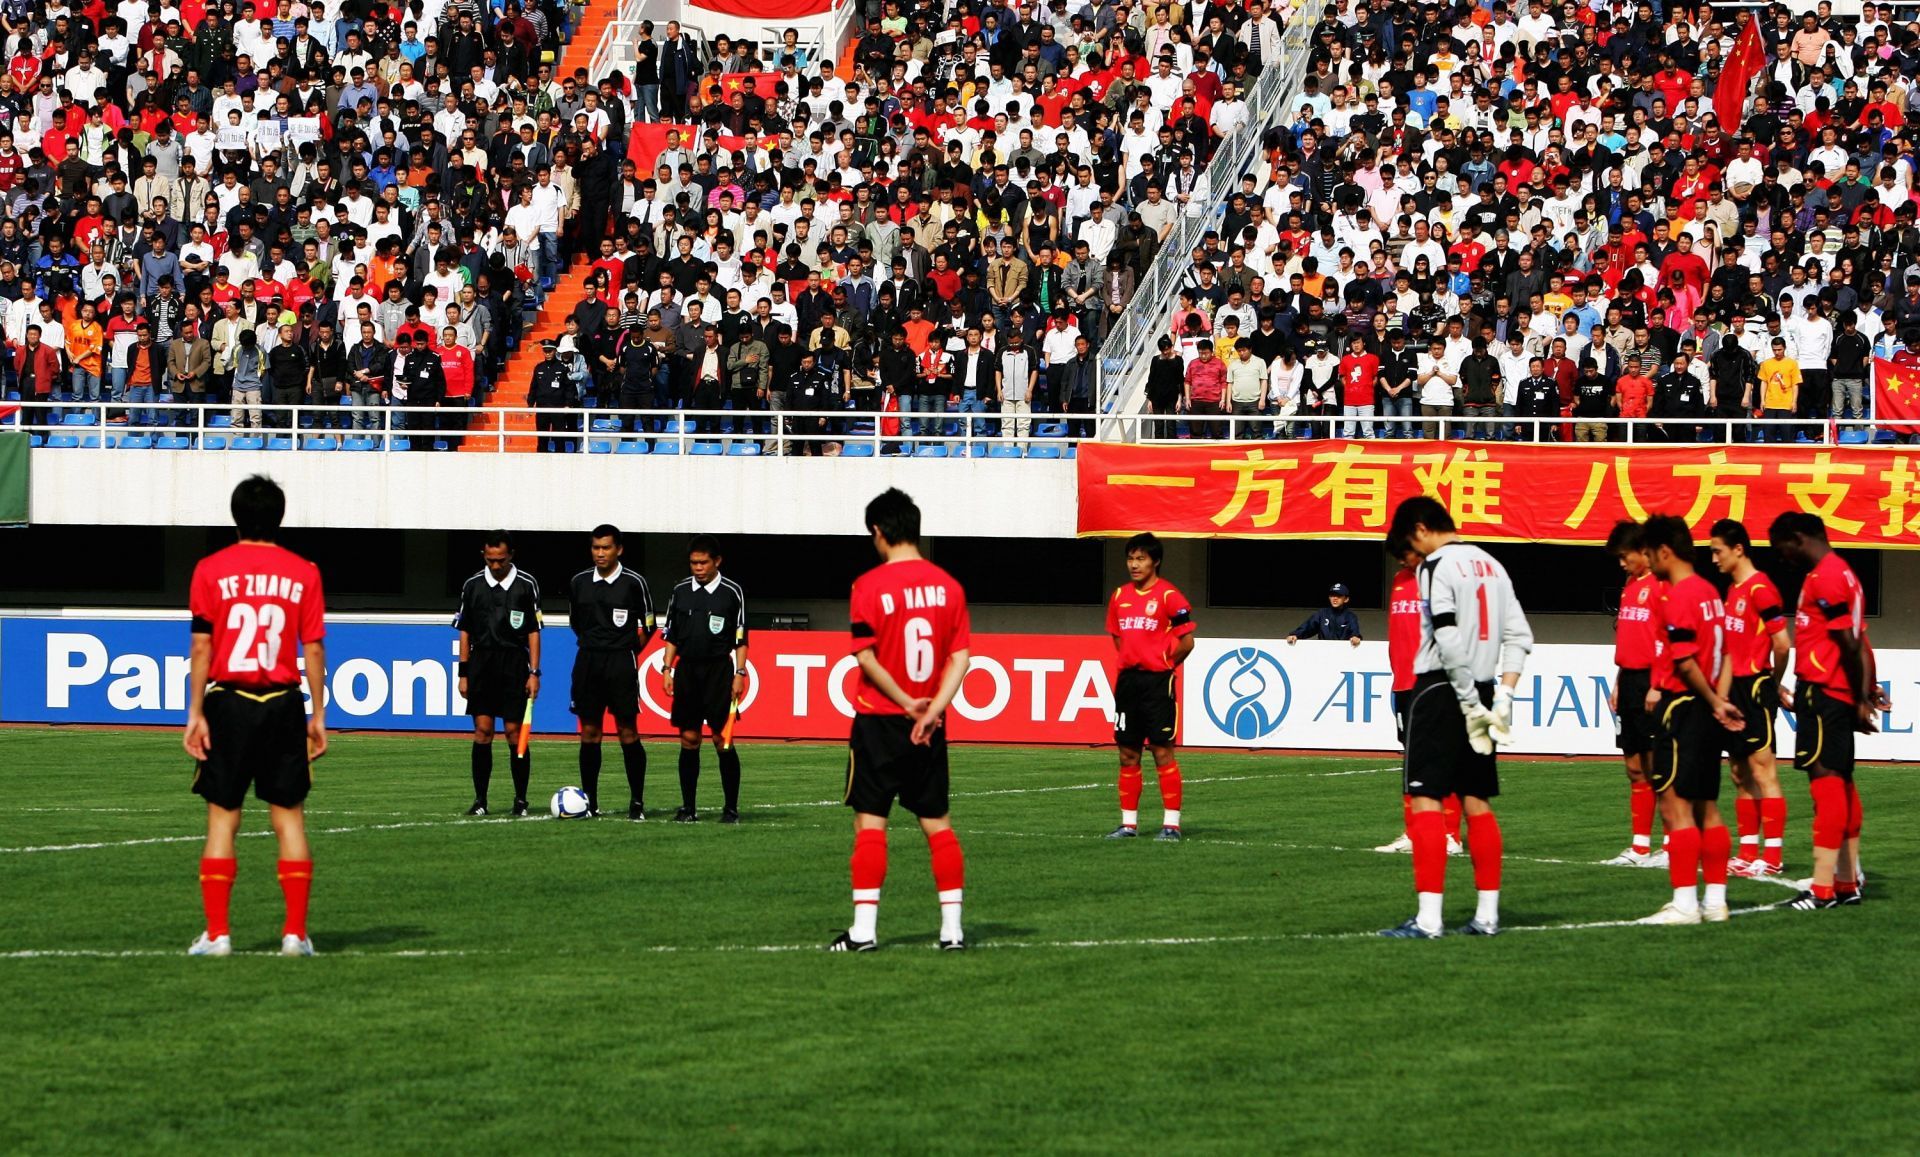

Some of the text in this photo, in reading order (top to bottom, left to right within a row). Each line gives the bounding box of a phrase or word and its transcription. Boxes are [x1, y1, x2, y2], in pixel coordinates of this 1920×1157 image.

[1107, 444, 1504, 529] 一方有难
[217, 574, 304, 604] XF ZHANG
[1476, 583, 1488, 640] 1
[227, 603, 286, 672] 23
[904, 617, 934, 683] 6
[1313, 671, 1396, 722] AF
